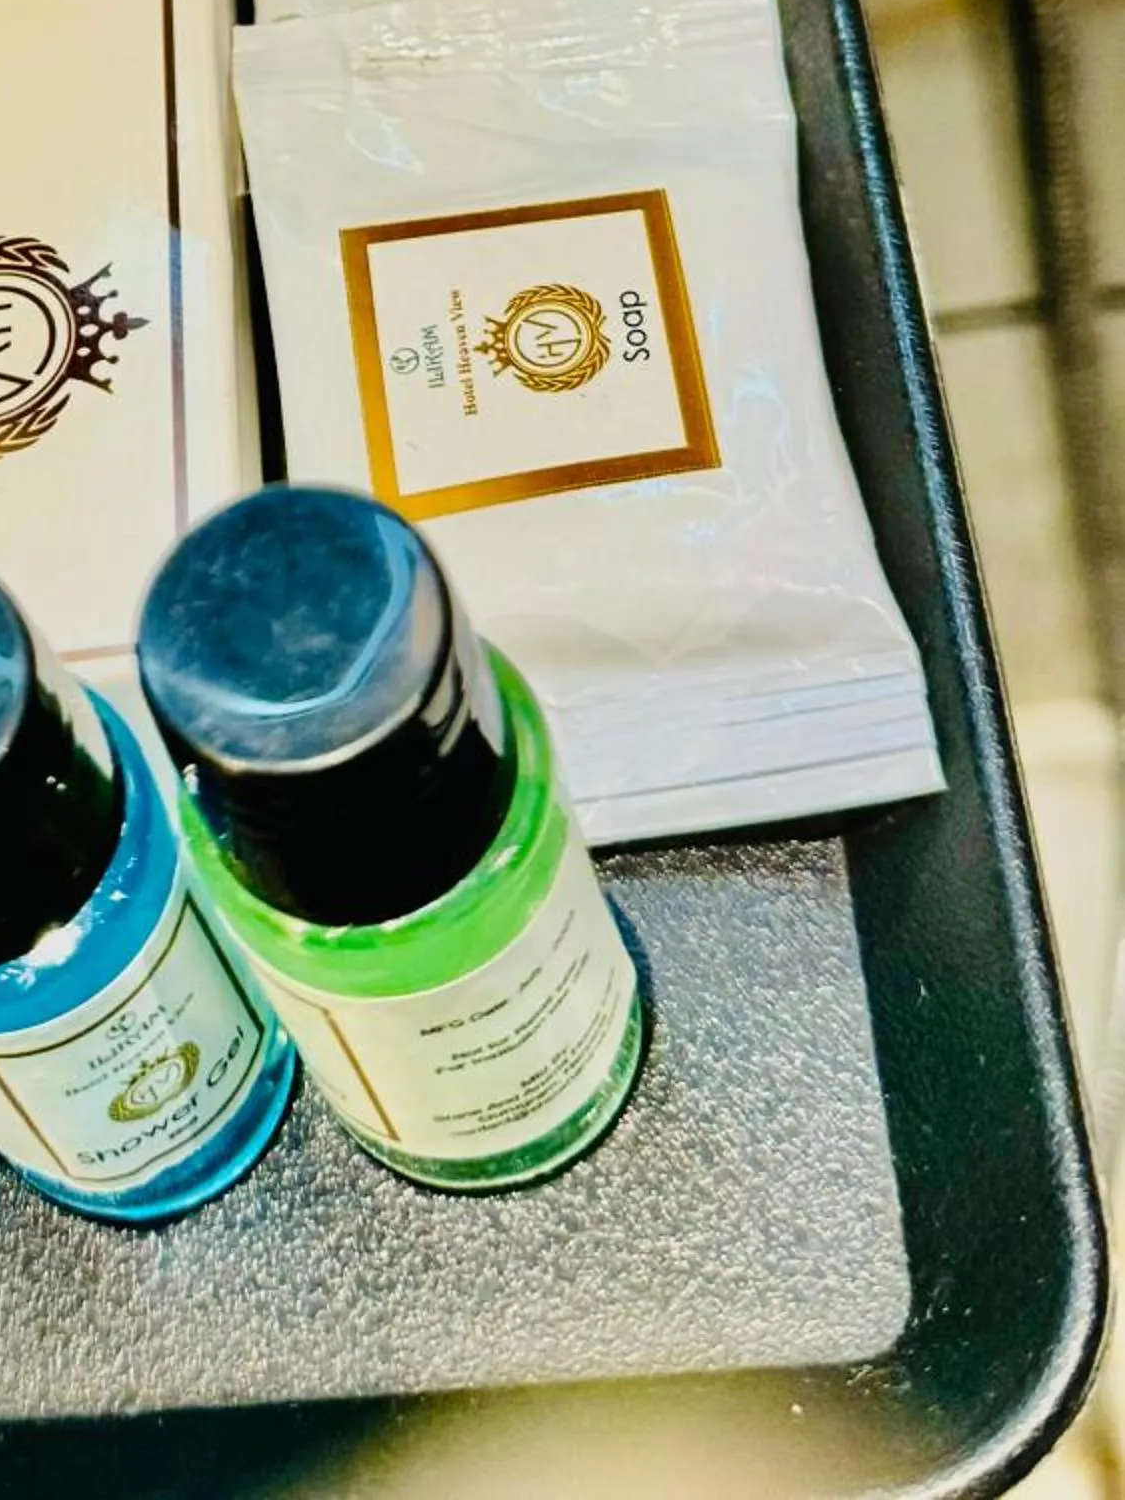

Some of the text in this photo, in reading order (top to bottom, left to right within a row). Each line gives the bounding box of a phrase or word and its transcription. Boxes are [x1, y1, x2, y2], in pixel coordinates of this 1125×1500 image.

[618, 289, 650, 363] Soap
[76, 1092, 199, 1165] Shower
[206, 1025, 245, 1088] Gel
